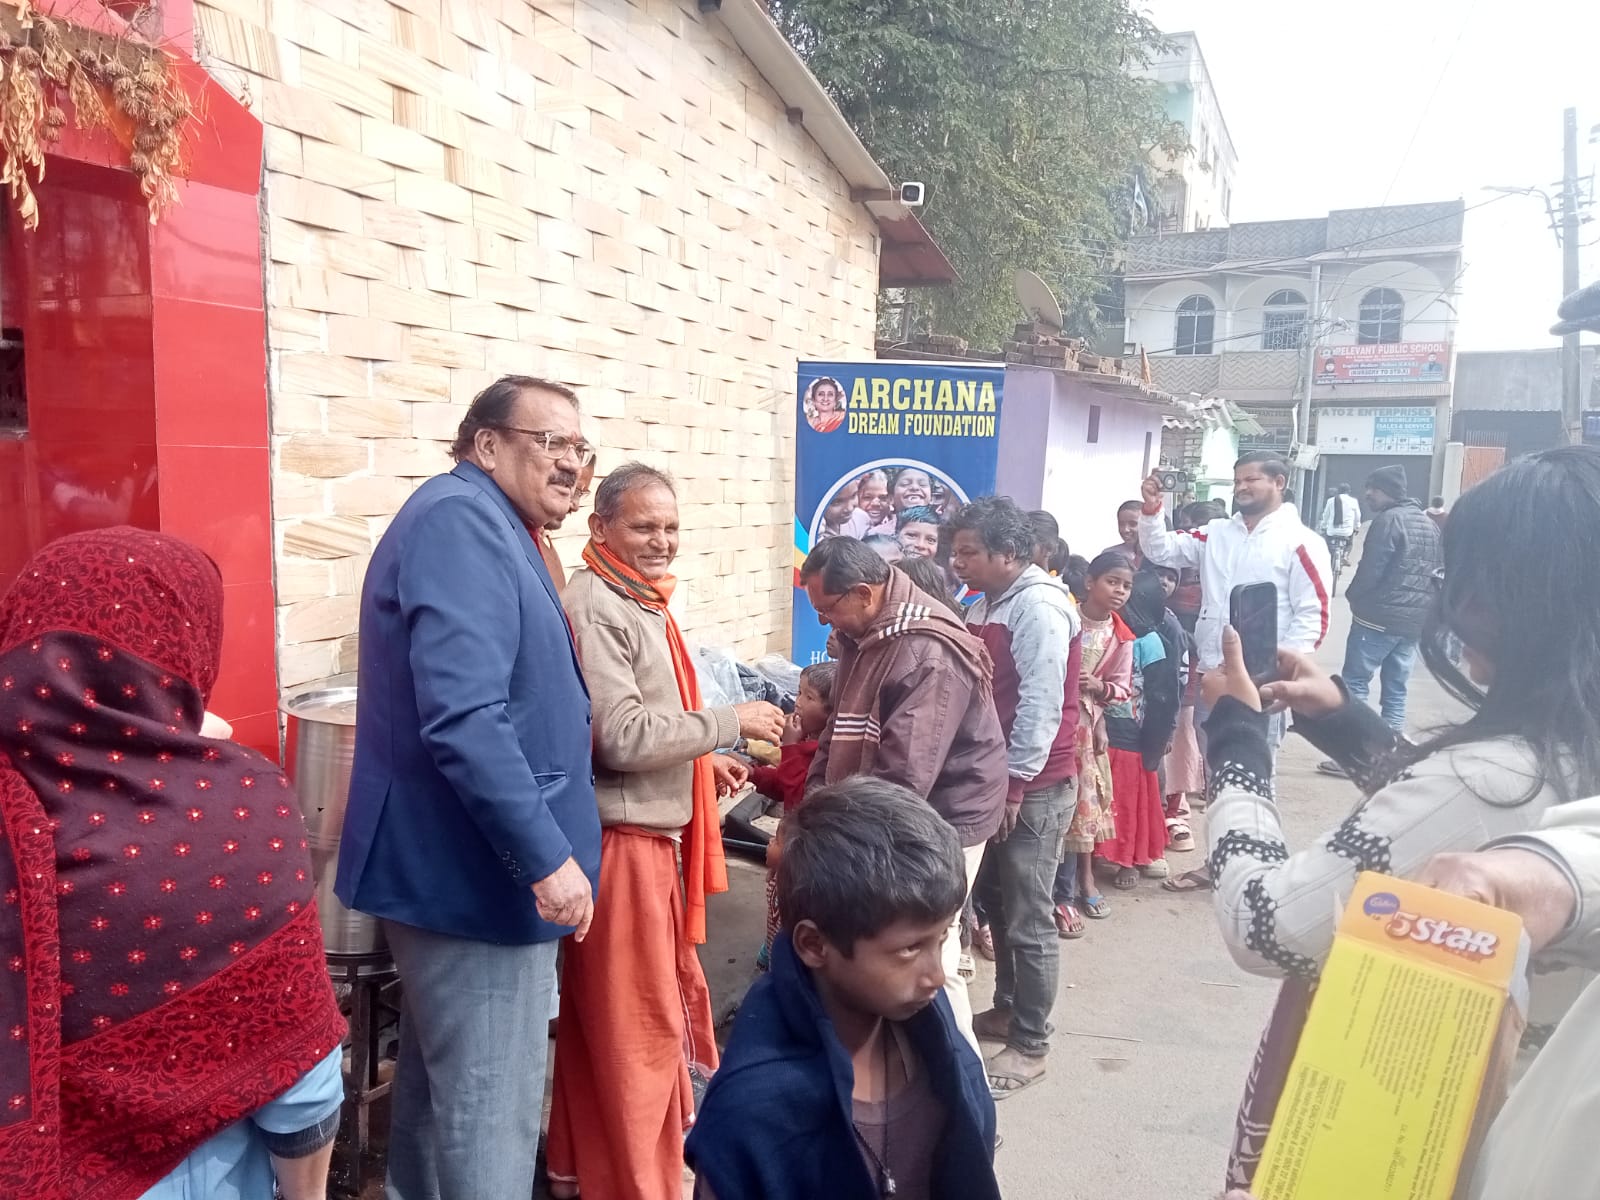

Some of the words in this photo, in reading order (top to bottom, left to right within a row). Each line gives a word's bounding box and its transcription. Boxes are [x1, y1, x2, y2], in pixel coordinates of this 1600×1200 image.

[1378, 344, 1408, 354] PUBLIC
[1411, 343, 1444, 353] SCHOOL
[848, 377, 996, 413] ARCHANA
[1358, 408, 1432, 416] ENTERPRISES
[847, 413, 900, 435] DREAM
[904, 414, 996, 437] FOUNDATION
